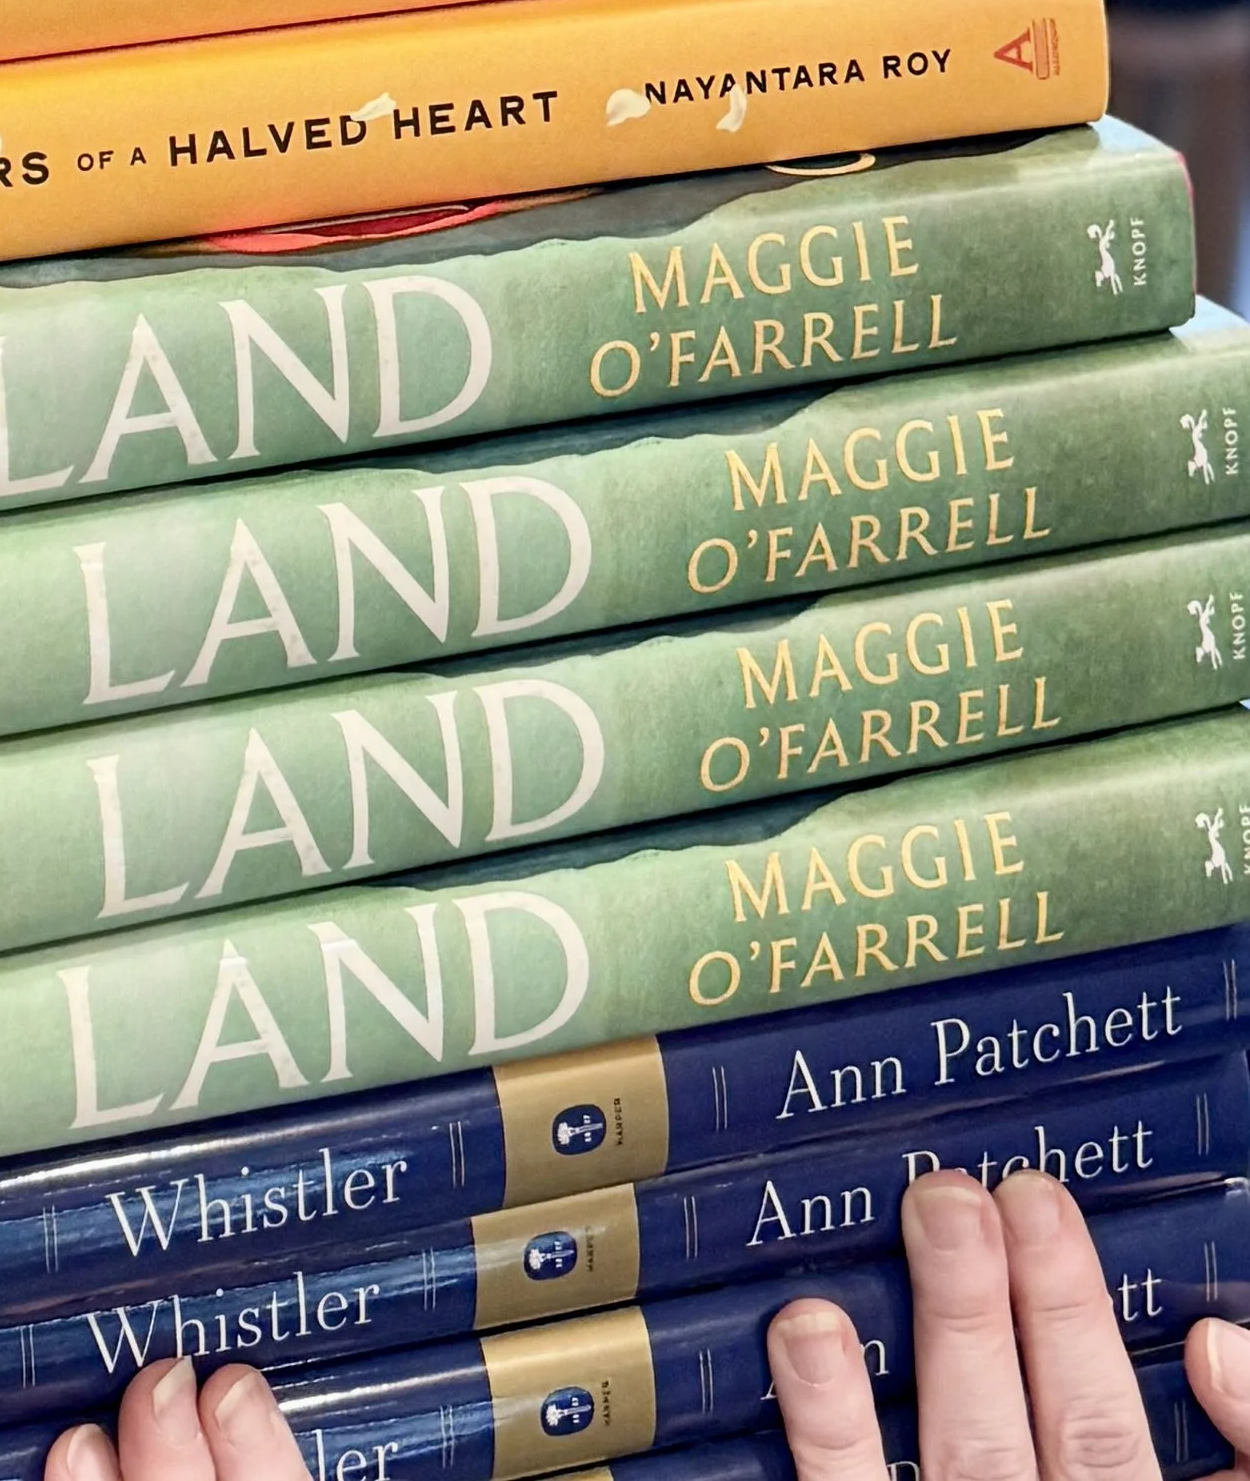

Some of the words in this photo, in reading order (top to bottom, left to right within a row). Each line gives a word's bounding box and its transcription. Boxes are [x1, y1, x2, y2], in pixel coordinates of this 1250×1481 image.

[644, 58, 864, 106] NAYANTARA
[882, 48, 952, 79] ROY
[76, 149, 115, 173] OF
[129, 146, 148, 168] A
[168, 114, 367, 167] HALVED
[392, 90, 559, 140] HEART
[628, 215, 919, 315] MAGGIE
[1130, 214, 1147, 287] KNOPF
[589, 294, 958, 399] O'FARRELL
[726, 408, 1015, 513] MAGGIE
[1222, 404, 1239, 476] KNOPF
[73, 476, 592, 707] LAND
[688, 487, 1051, 595] O'FARRELL
[736, 599, 1024, 708] MAGGIE
[1229, 589, 1246, 661] KNOPF
[700, 676, 1061, 794] O'FARRELL
[85, 678, 605, 921] LAND
[725, 811, 1025, 924] MAGGIE
[688, 891, 1065, 1007] O'FARRELL
[56, 891, 591, 1131] LAND
[776, 1050, 907, 1119] Ann
[930, 985, 1183, 1086] Patchett
[107, 1149, 408, 1259] Whistler
[746, 1179, 875, 1247] Ann
[901, 1120, 1154, 1187] Ptchett
[86, 1271, 380, 1375] Whistler
